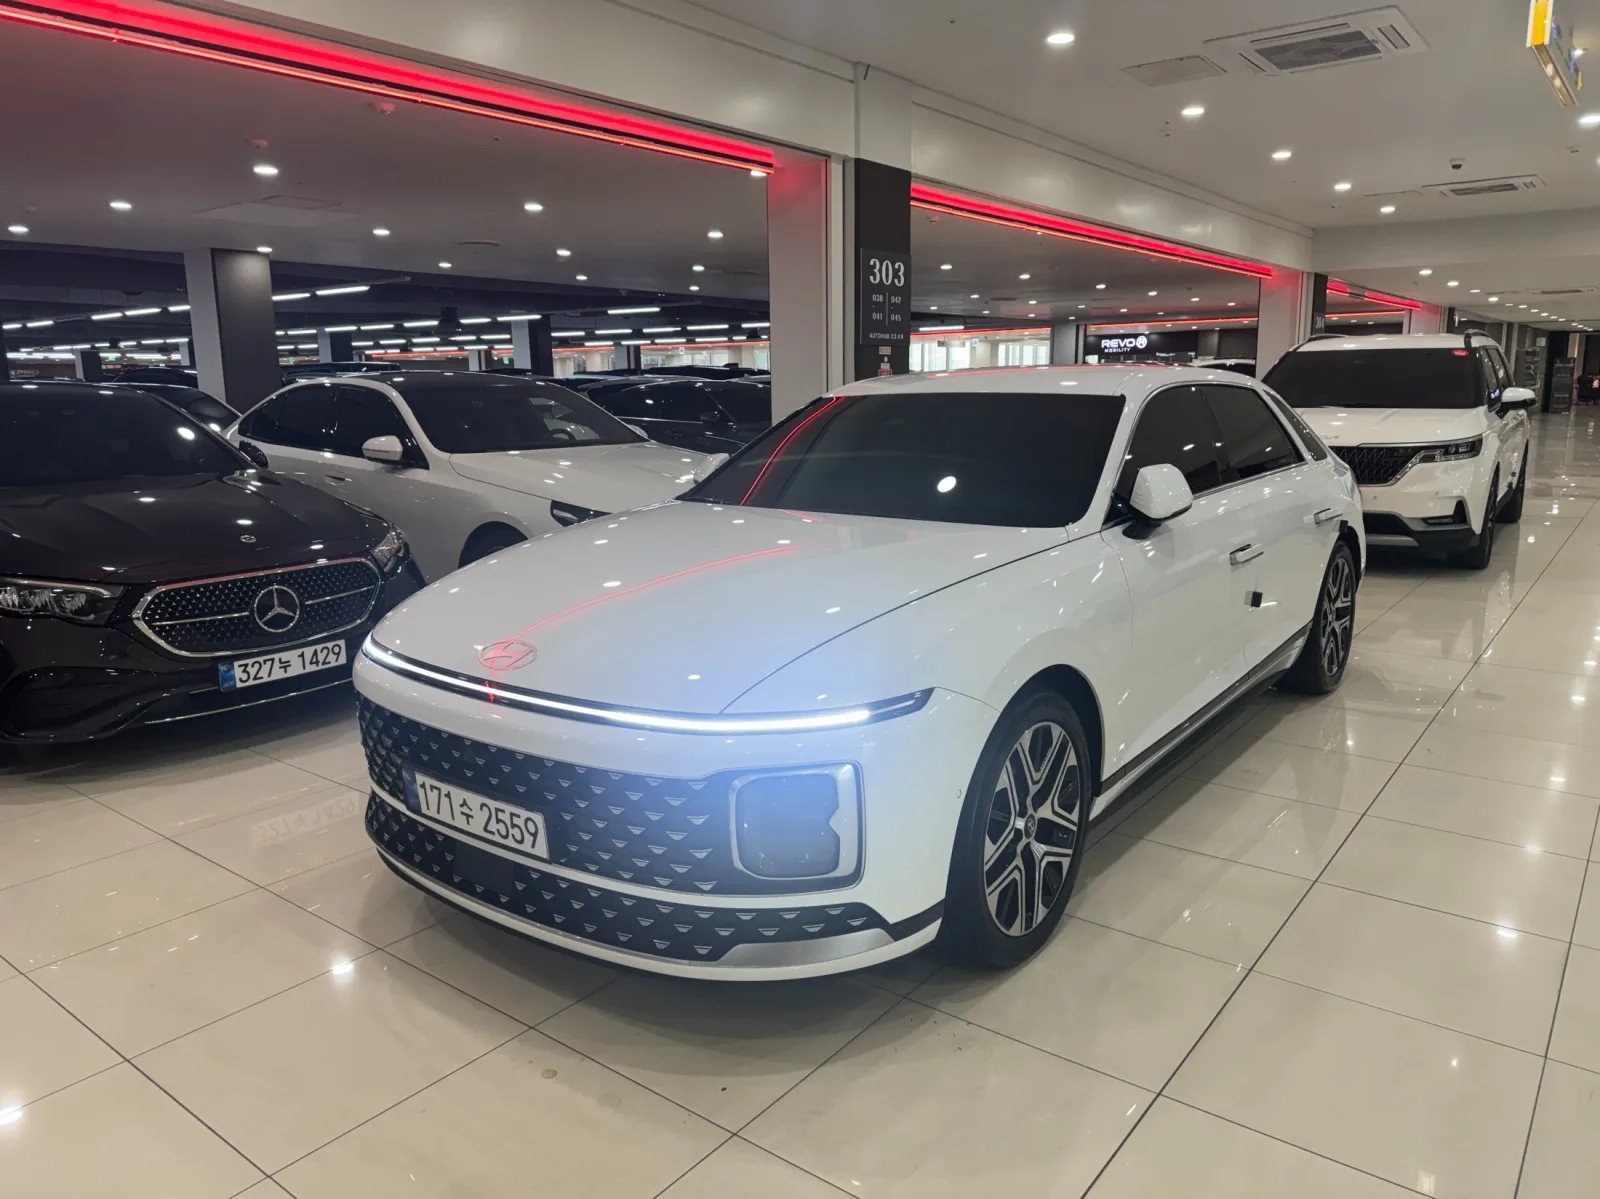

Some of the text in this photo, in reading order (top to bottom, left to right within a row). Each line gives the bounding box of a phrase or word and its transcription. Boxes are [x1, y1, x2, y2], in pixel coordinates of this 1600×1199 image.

[869, 258, 905, 287] 303
[872, 294, 884, 302] 038
[1101, 338, 1136, 349] REVO
[237, 643, 343, 684] 327누 1429
[419, 780, 540, 849] 171수 2559
